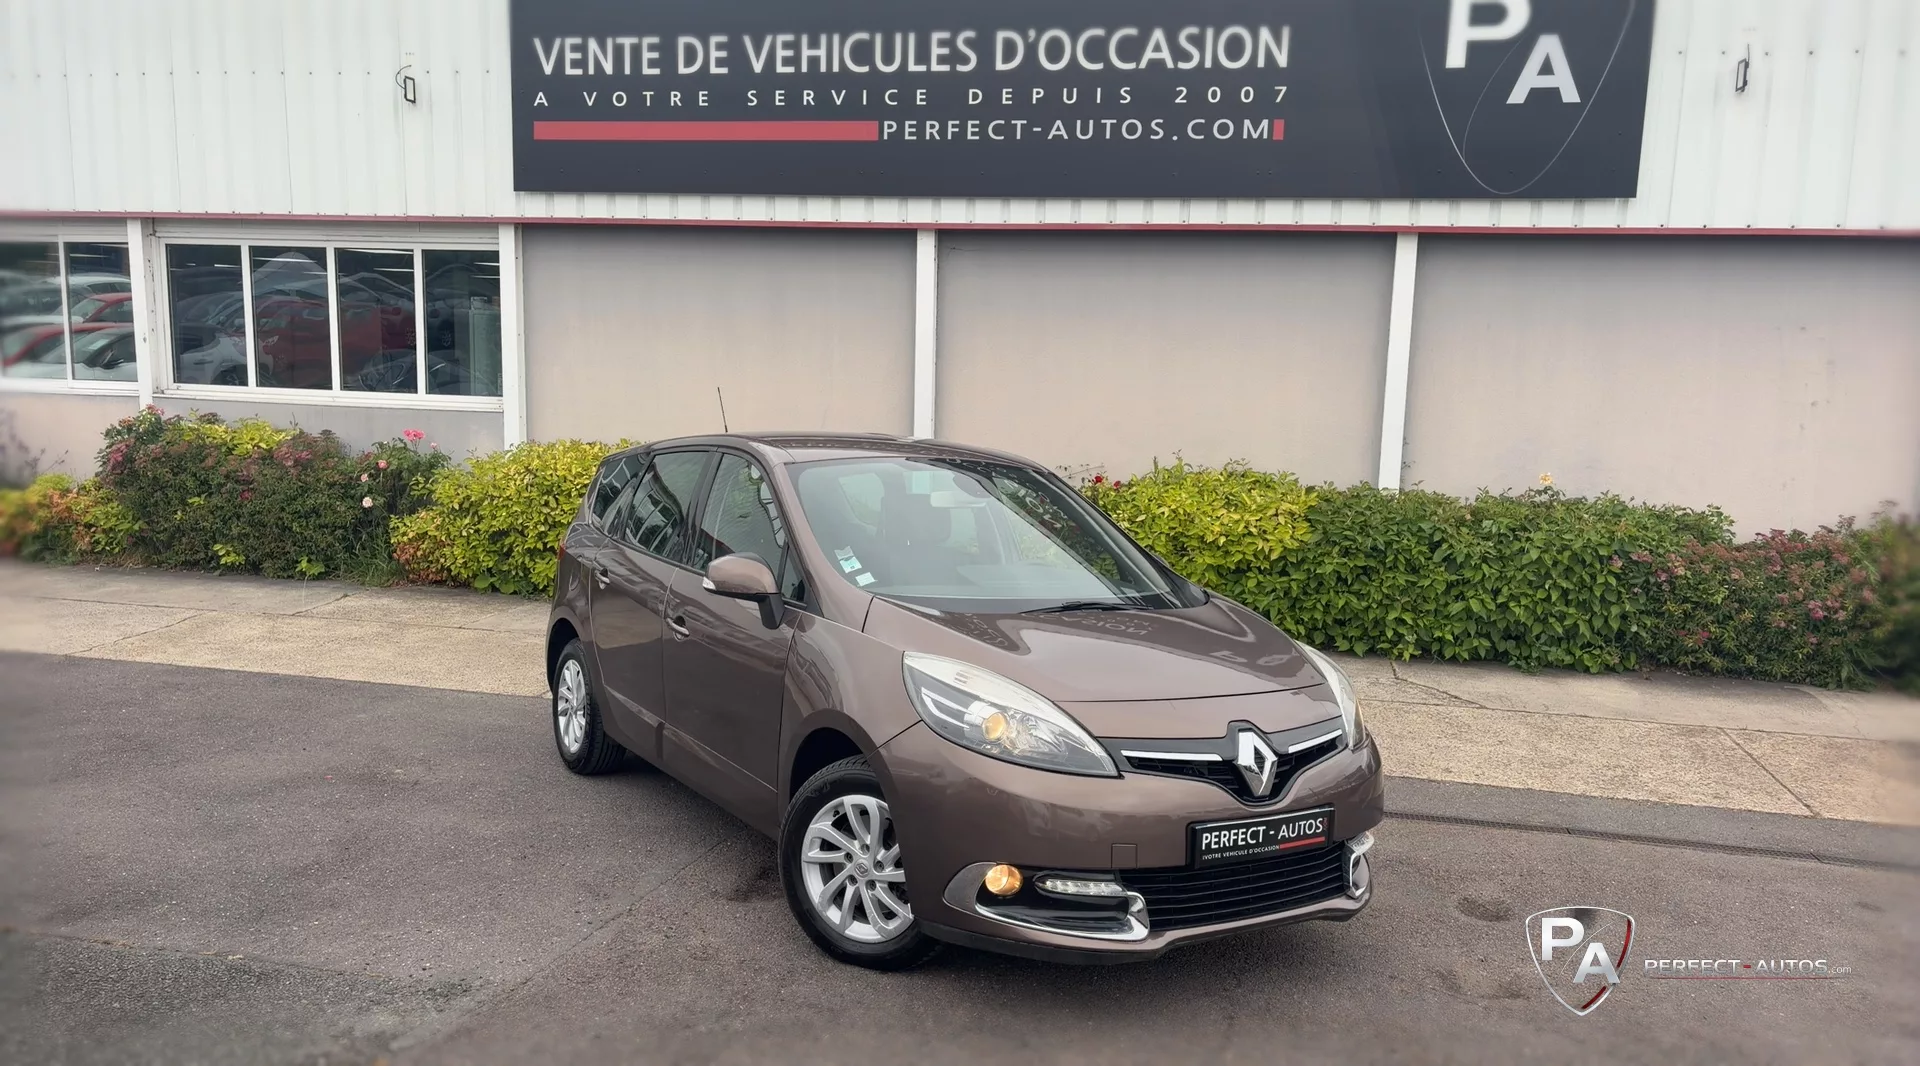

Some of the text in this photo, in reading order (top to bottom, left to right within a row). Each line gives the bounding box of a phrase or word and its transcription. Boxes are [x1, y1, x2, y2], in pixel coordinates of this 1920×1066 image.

[533, 26, 1290, 76] VENTE DE VEHICULES D'OCCASION
[533, 86, 1288, 107] A VOTRE SERVICE DEPUIS 2007
[883, 118, 1269, 141] PERFECT-AUTOS.COM
[1202, 826, 1267, 851] PERFECT
[1277, 817, 1323, 840] AUTOS
